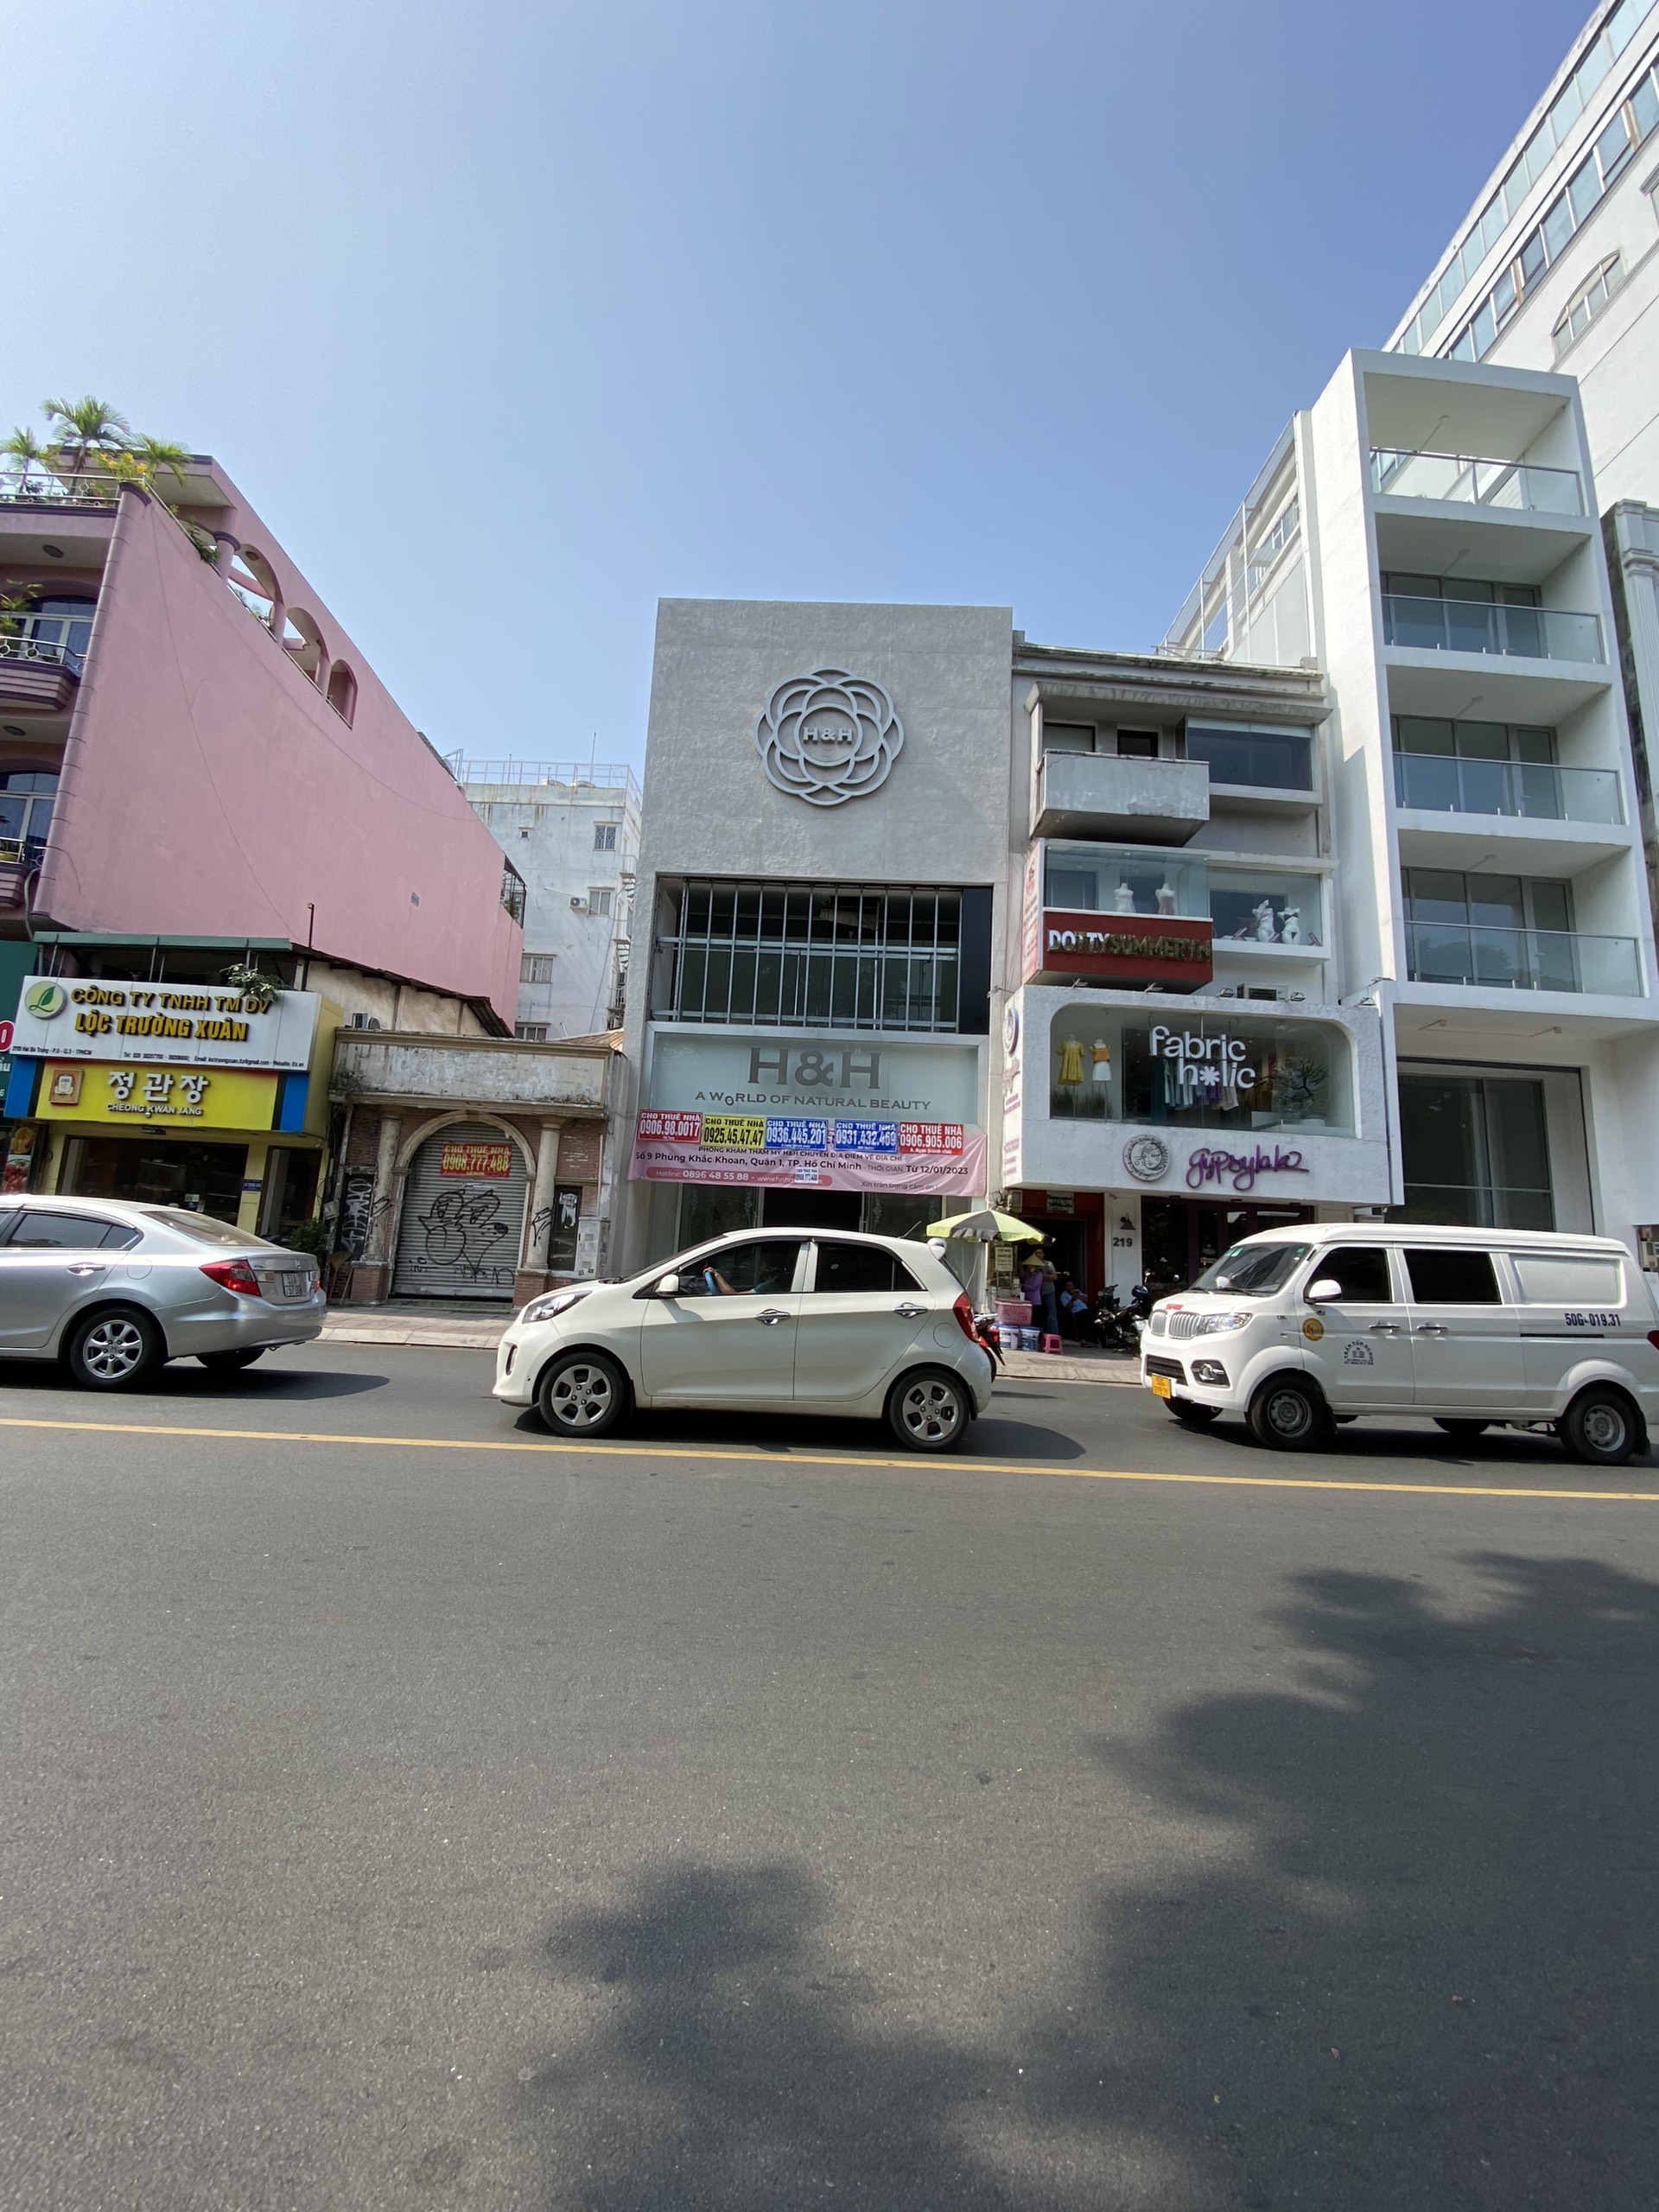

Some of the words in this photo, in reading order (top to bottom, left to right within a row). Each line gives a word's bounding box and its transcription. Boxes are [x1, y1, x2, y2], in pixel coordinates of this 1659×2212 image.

[803, 726, 853, 744] H&H
[71, 985, 124, 1005] CÔNG
[130, 991, 154, 1008] TY
[159, 992, 209, 1010] TNHH
[214, 995, 240, 1013] TM
[245, 997, 272, 1014] DV
[75, 1010, 111, 1036] LỘC
[116, 1012, 191, 1039] TRƯỜNG
[1150, 1026, 1246, 1063] fabric
[747, 1046, 881, 1090] H&H
[107, 1071, 209, 1103] 정관장
[695, 1090, 706, 1101] A
[709, 1091, 767, 1106] WORLD
[770, 1095, 791, 1104] OF
[794, 1096, 867, 1108] NATURAL
[869, 1099, 931, 1110] BEAUTY
[107, 1103, 145, 1113] CHEONG
[147, 1105, 175, 1114] KWAN
[177, 1107, 203, 1116] JANG
[683, 1113, 701, 1122] NHÀ
[639, 1119, 701, 1137] 0906.98.0017
[724, 1118, 745, 1127] THUÊ
[900, 1124, 918, 1133] CHO
[920, 1124, 942, 1135] THUÊ
[944, 1125, 962, 1136] NHÀ
[703, 1127, 764, 1147] 0925.45.47.47
[766, 1127, 826, 1145] 0936.445.201
[836, 1129, 896, 1147] 0931.432.469
[899, 1134, 962, 1148] 0906.905.006
[467, 1146, 488, 1154] THUÊ
[491, 1146, 510, 1155] NHÀ
[442, 1154, 510, 1172] 0908.777.488
[636, 1150, 645, 1160] Số
[655, 1152, 685, 1163] Phùng
[689, 1154, 712, 1164] Khắc
[715, 1155, 747, 1166] Khoan,
[750, 1157, 776, 1168] Quận
[804, 1159, 817, 1167] Hồ
[820, 1160, 836, 1168] Chí
[838, 1161, 861, 1170] Minh
[921, 1166, 969, 1175] 12/01/2023
[683, 1169, 707, 1179] 0896
[709, 1171, 721, 1179] 48
[723, 1172, 734, 1180] 55
[736, 1173, 749, 1181] 88
[1113, 1236, 1133, 1248] 219
[1565, 1313, 1621, 1326] 50G-019.31
